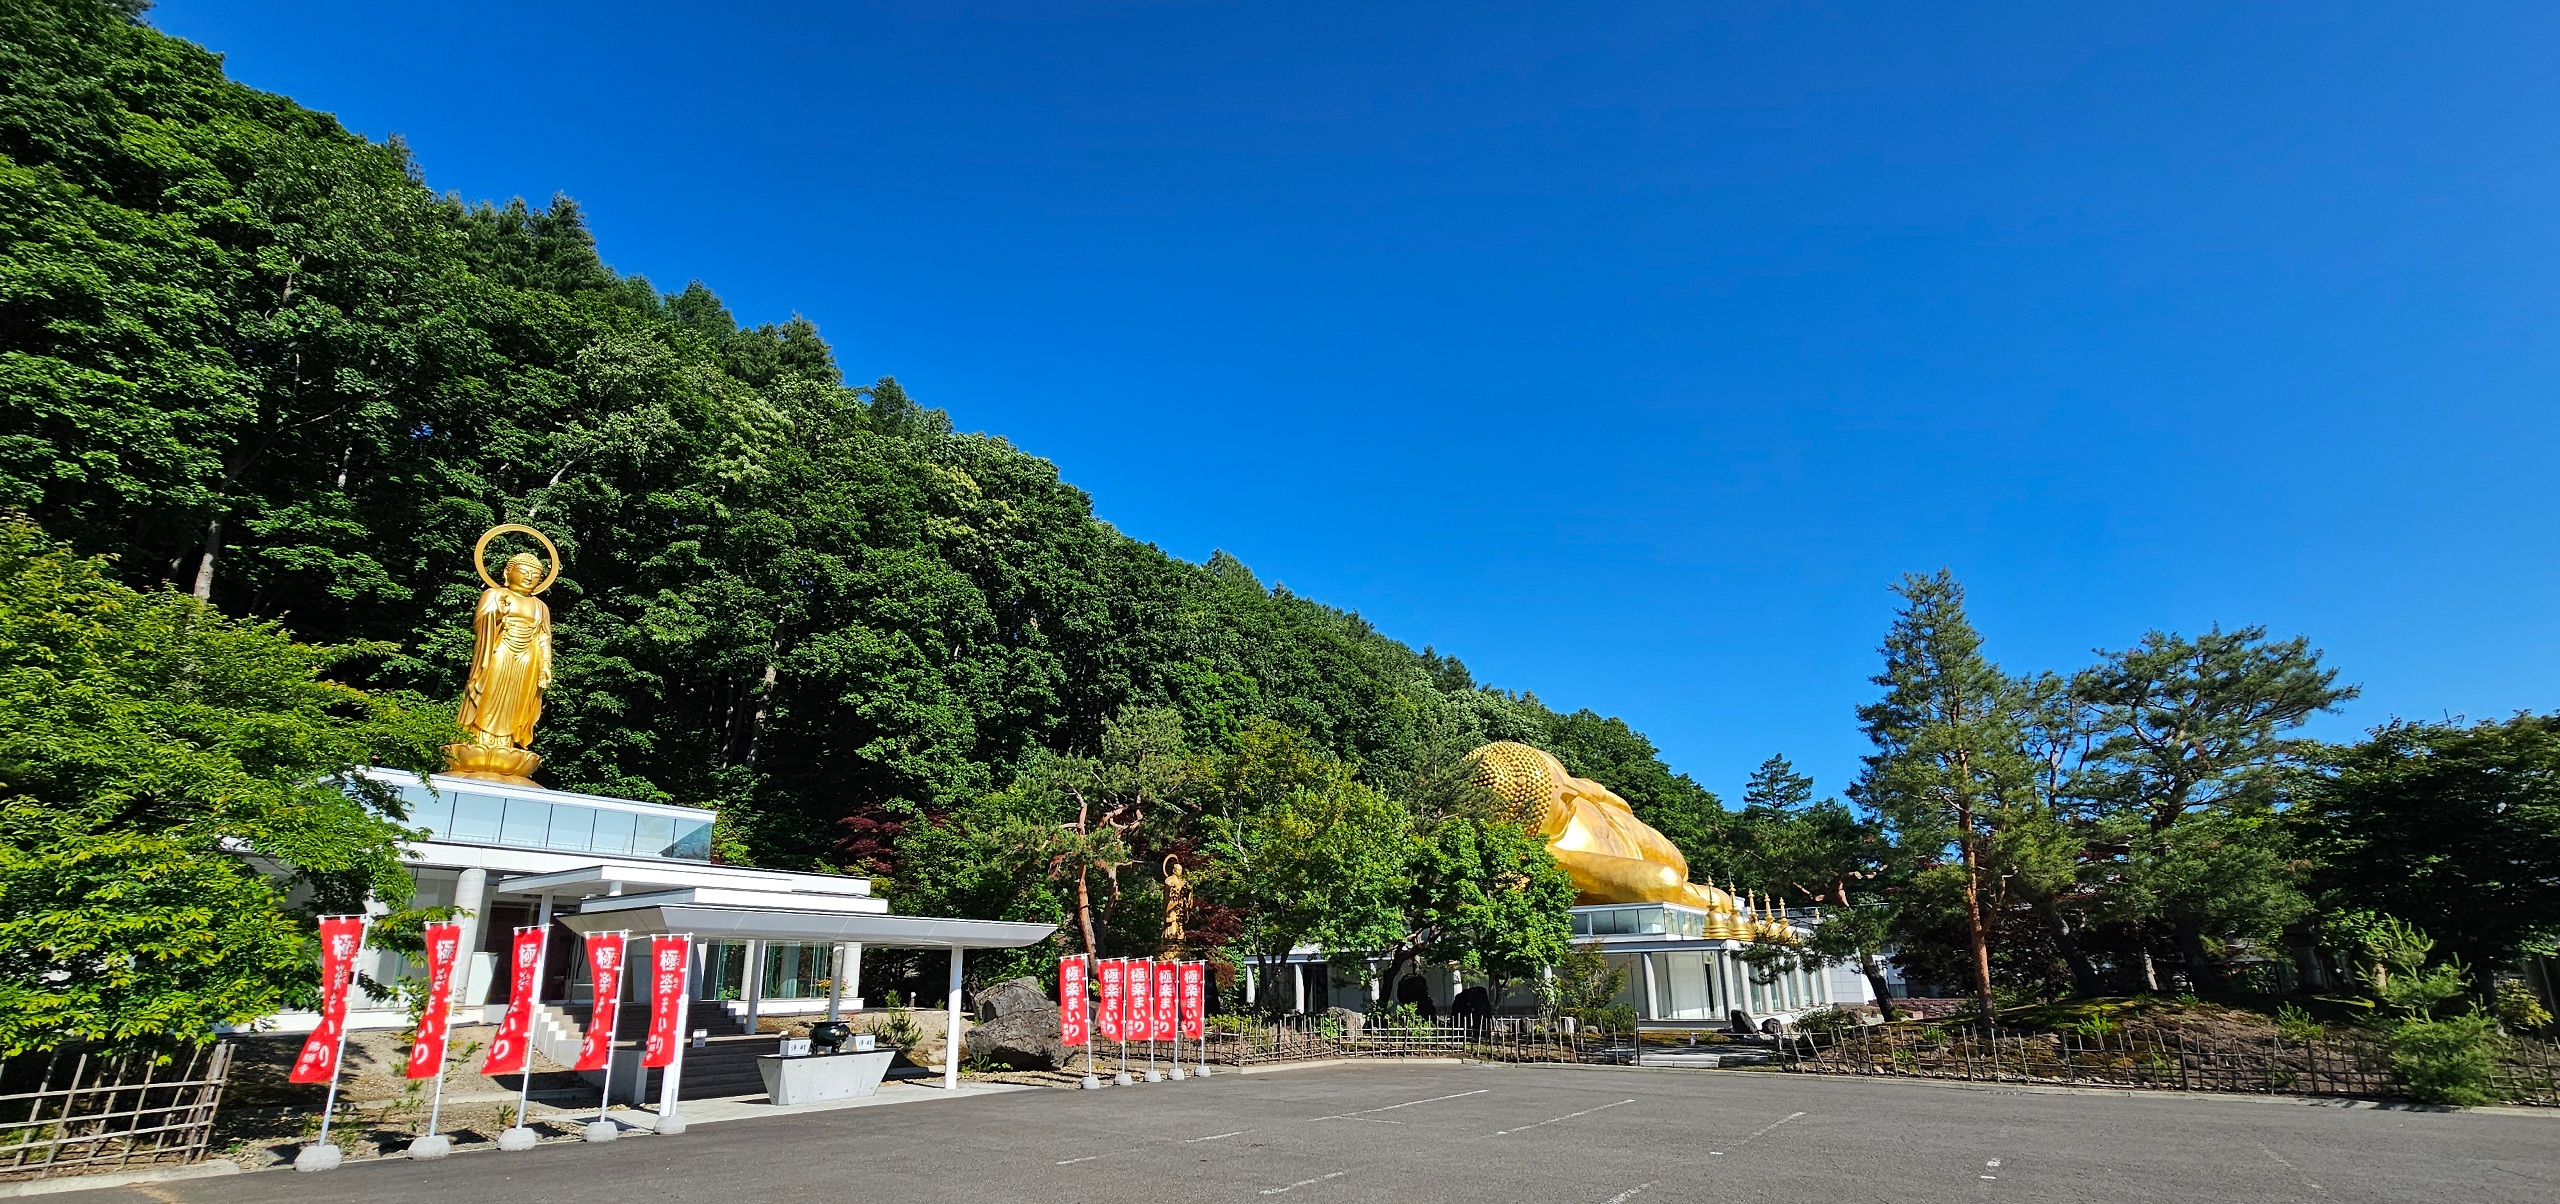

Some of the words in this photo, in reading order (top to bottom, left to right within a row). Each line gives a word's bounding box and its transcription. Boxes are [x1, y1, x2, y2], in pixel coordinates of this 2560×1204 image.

[657, 949, 679, 1055] 極楽まいり
[1065, 965, 1081, 1037] 極楽まいり
[1103, 968, 1119, 1034] 極楽まいり
[1130, 967, 1146, 1033] 極楽まいり
[1158, 969, 1173, 1033] 極楽まいり
[1184, 969, 1199, 1032] 極楽まいり
